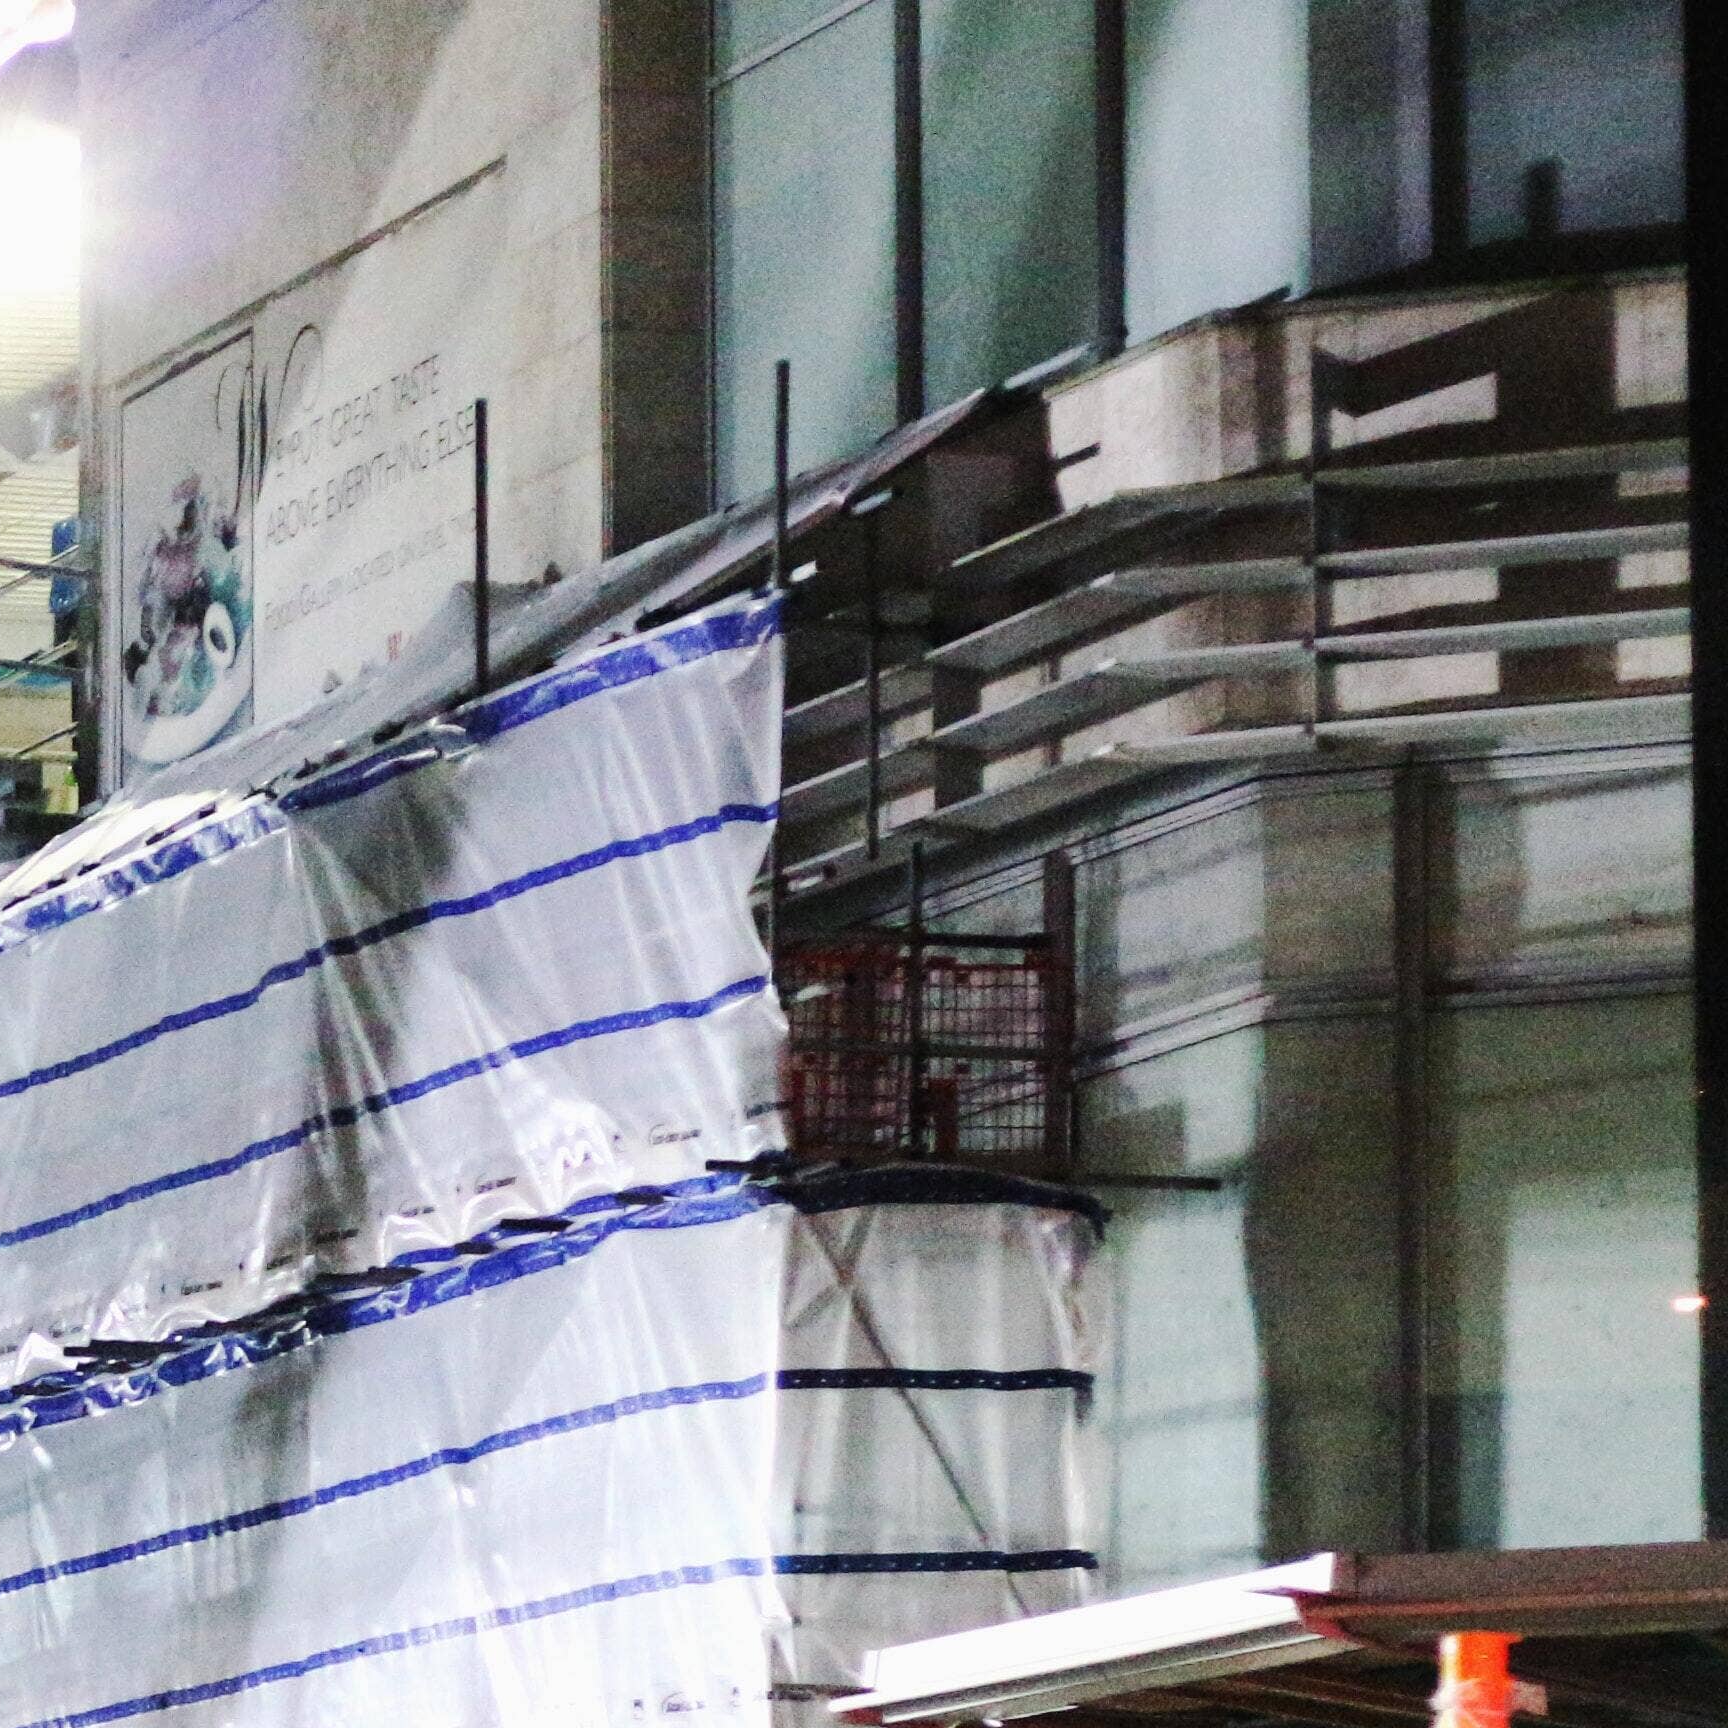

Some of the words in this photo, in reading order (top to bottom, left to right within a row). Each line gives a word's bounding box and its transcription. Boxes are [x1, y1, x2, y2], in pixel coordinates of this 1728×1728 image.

[331, 384, 382, 448] GREAT
[391, 353, 440, 412] TASTE
[266, 487, 319, 548] ABOVE
[326, 428, 429, 521] EVERYTHING
